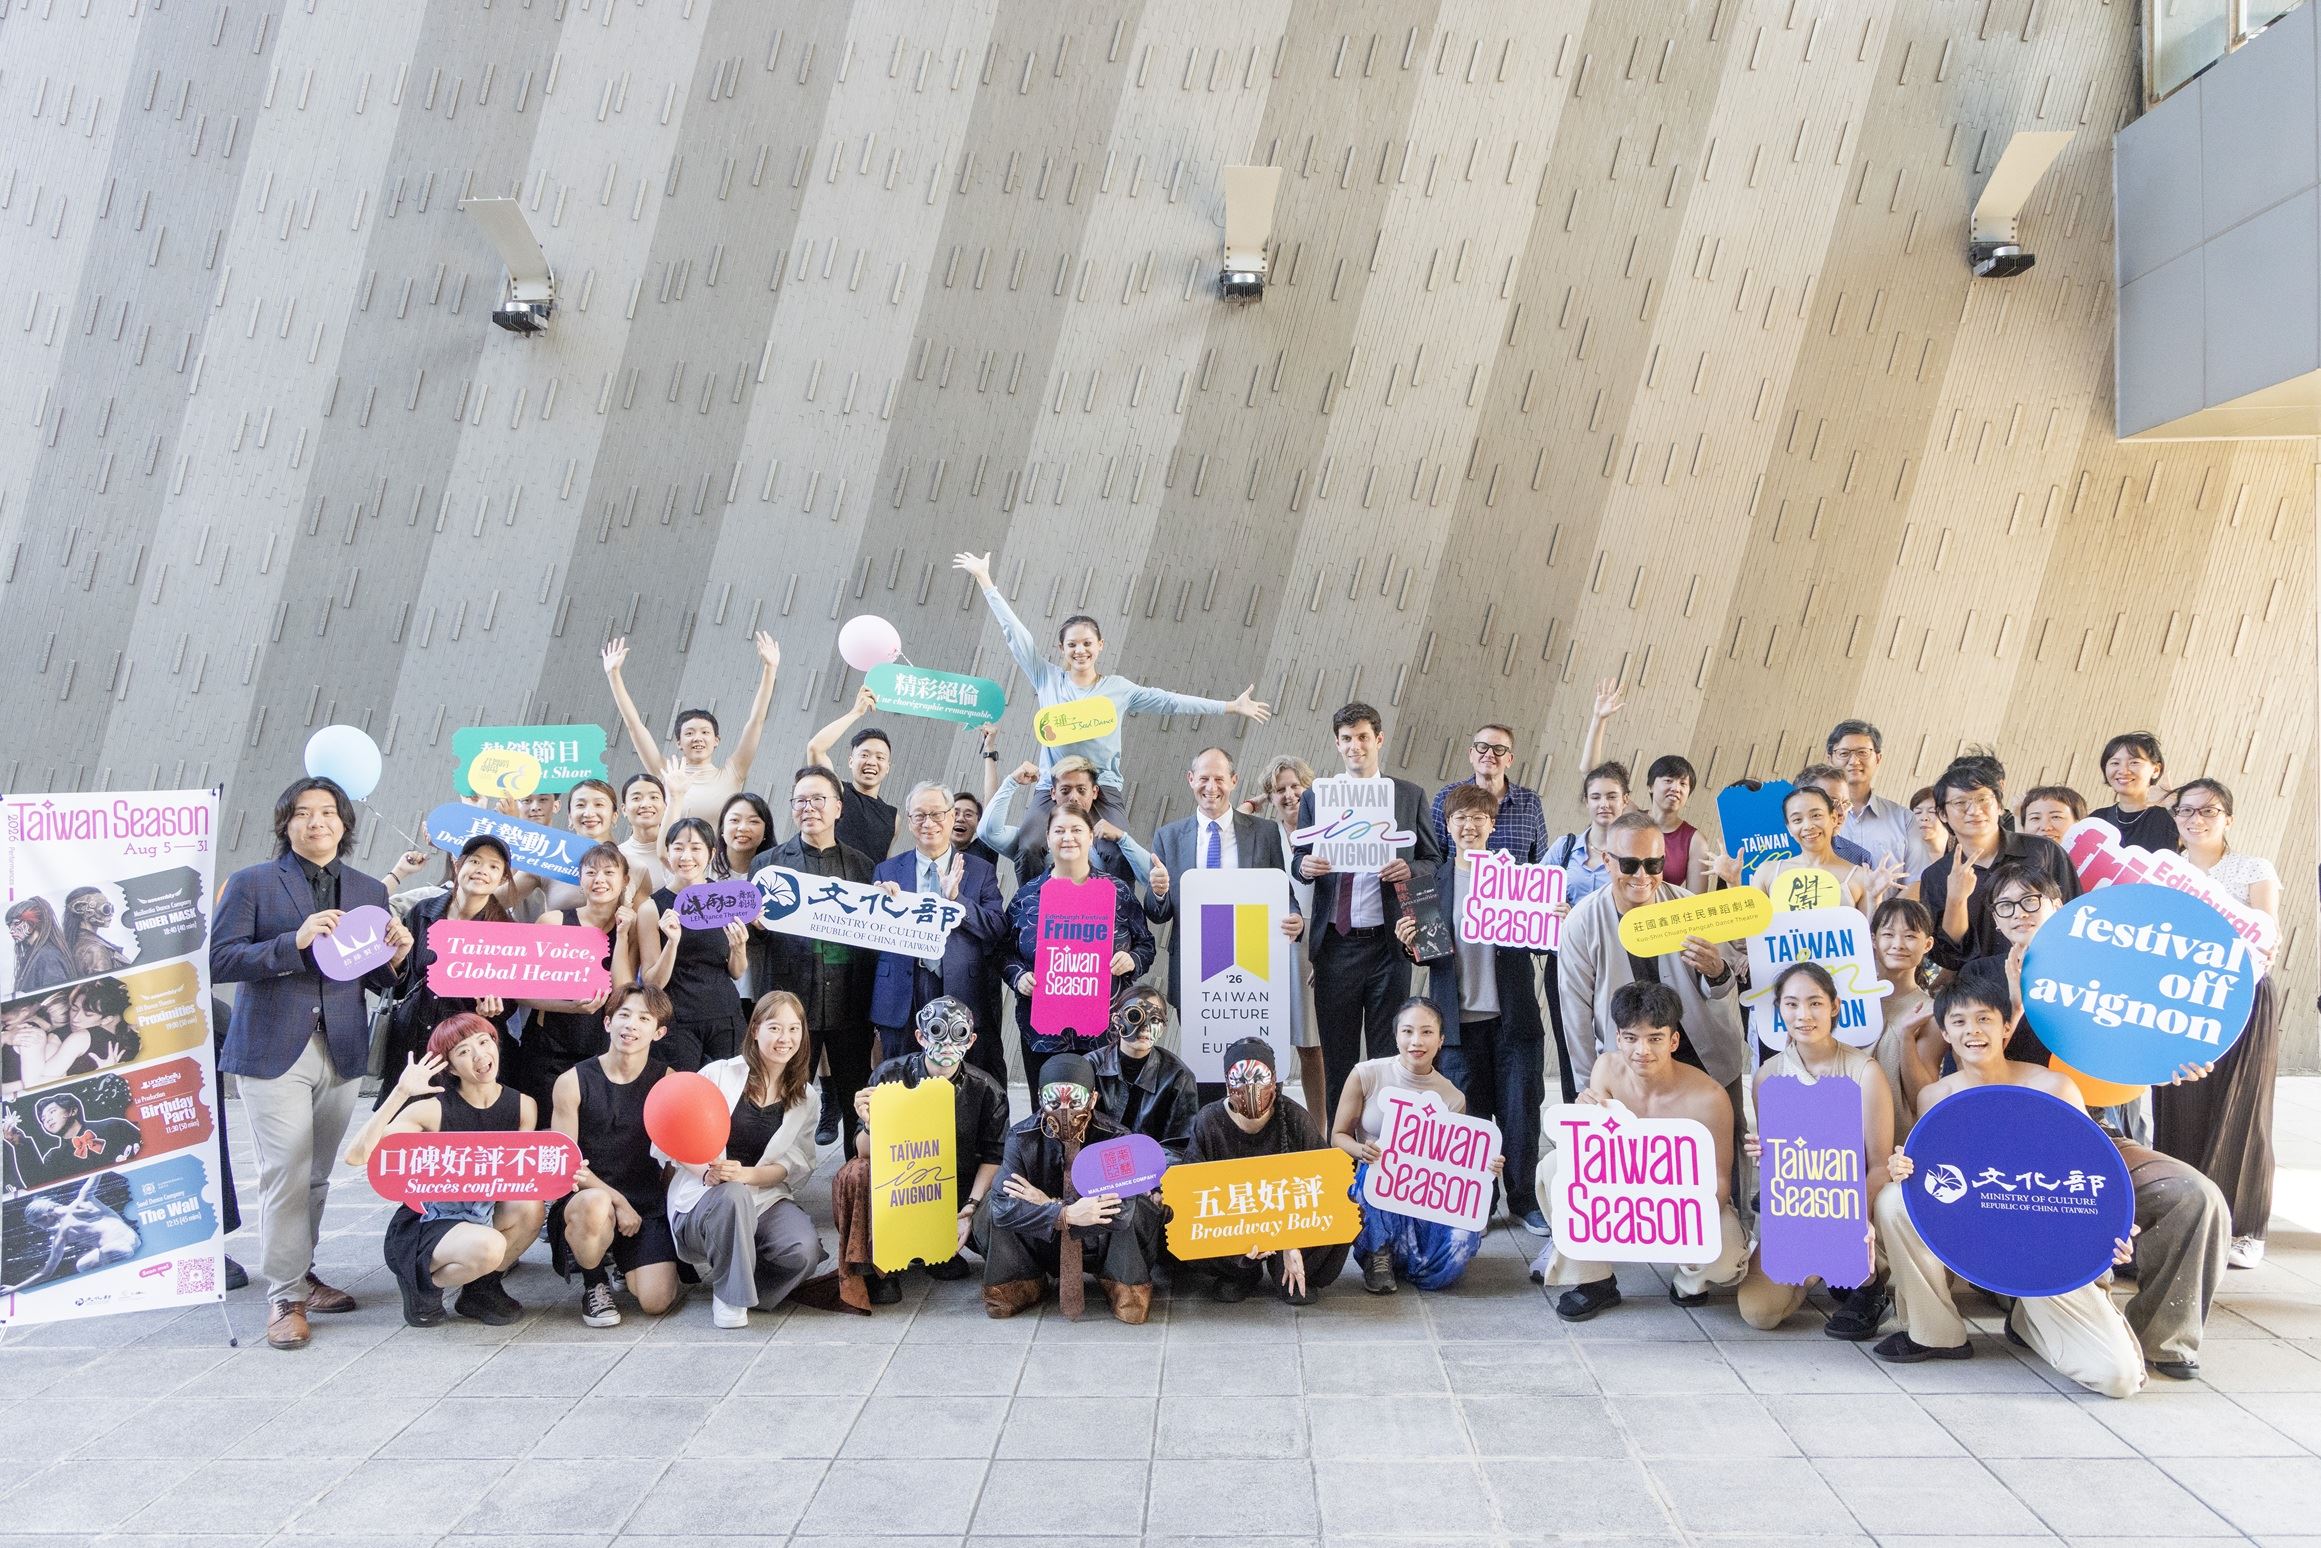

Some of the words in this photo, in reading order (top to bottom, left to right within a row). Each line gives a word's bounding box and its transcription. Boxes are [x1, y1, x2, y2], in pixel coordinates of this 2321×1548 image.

[894, 672, 980, 707] 精彩絕倫
[551, 766, 592, 779] Show
[1319, 780, 1388, 807] TAÏWAN
[7, 800, 108, 841] Taiwan
[113, 800, 208, 838] Season
[8, 814, 19, 842] 2026
[124, 842, 157, 857] Aug
[436, 830, 467, 847] Drôl
[1742, 833, 1790, 853] TAÏWAN
[526, 857, 540, 866] et
[540, 861, 580, 877] sensib
[1468, 853, 1563, 903] Taiwan
[135, 914, 169, 931] UNDER
[168, 908, 196, 923] MASK
[808, 882, 960, 932] 文化部
[1464, 896, 1560, 947] Season
[810, 923, 851, 938] REPUBLIC
[853, 932, 865, 941] OF
[867, 934, 896, 946] CHINA
[899, 939, 940, 954] (TAIWAN)
[812, 912, 868, 929] MINISTRY
[870, 922, 885, 932] OF
[888, 926, 941, 942] CULTURE
[1044, 919, 1108, 943] Fringe
[2068, 905, 2245, 973] festival
[447, 937, 527, 957] Taiwan
[535, 940, 596, 962] Voice,
[1046, 945, 1099, 973] Taiwan
[1764, 928, 1855, 963] TAÏWAN
[446, 961, 517, 980] Global
[521, 963, 591, 983] Heart!
[1045, 971, 1098, 996] Season
[1202, 991, 1269, 1002] TAIWAN
[2159, 969, 2239, 1011] off
[1201, 1008, 1269, 1020] CULTURE
[2028, 978, 2223, 1046] avignon
[140, 1096, 193, 1119] Birthday
[162, 1107, 196, 1125] Party
[1389, 1098, 1491, 1172] Taiwan
[379, 1144, 569, 1177] 口碑好評不斷
[890, 1140, 939, 1162] TAÏWAN
[1560, 1116, 1699, 1185] Taiwan
[1767, 1136, 1858, 1182] Taiwan
[405, 1178, 459, 1194] Succès
[462, 1178, 538, 1197] confirmé.
[890, 1183, 942, 1208] AVIGNON
[1192, 1174, 1325, 1219] 五星好評
[1375, 1148, 1482, 1219] Season
[1972, 1167, 2106, 1197] 文化部
[138, 1208, 166, 1226] The
[166, 1196, 200, 1217] Wall
[1770, 1177, 1859, 1220] Season
[1980, 1192, 2029, 1203] MINISTRY
[2031, 1195, 2046, 1203] OF
[2048, 1196, 2097, 1206] CULTURE
[1981, 1201, 2018, 1210] REPUBLIC
[2032, 1204, 2059, 1213] CHINA
[2061, 1206, 2098, 1215] (TAIWAN)
[1190, 1218, 1283, 1241] Broadway
[1287, 1211, 1333, 1231] Baby
[1568, 1182, 1703, 1246] Season
